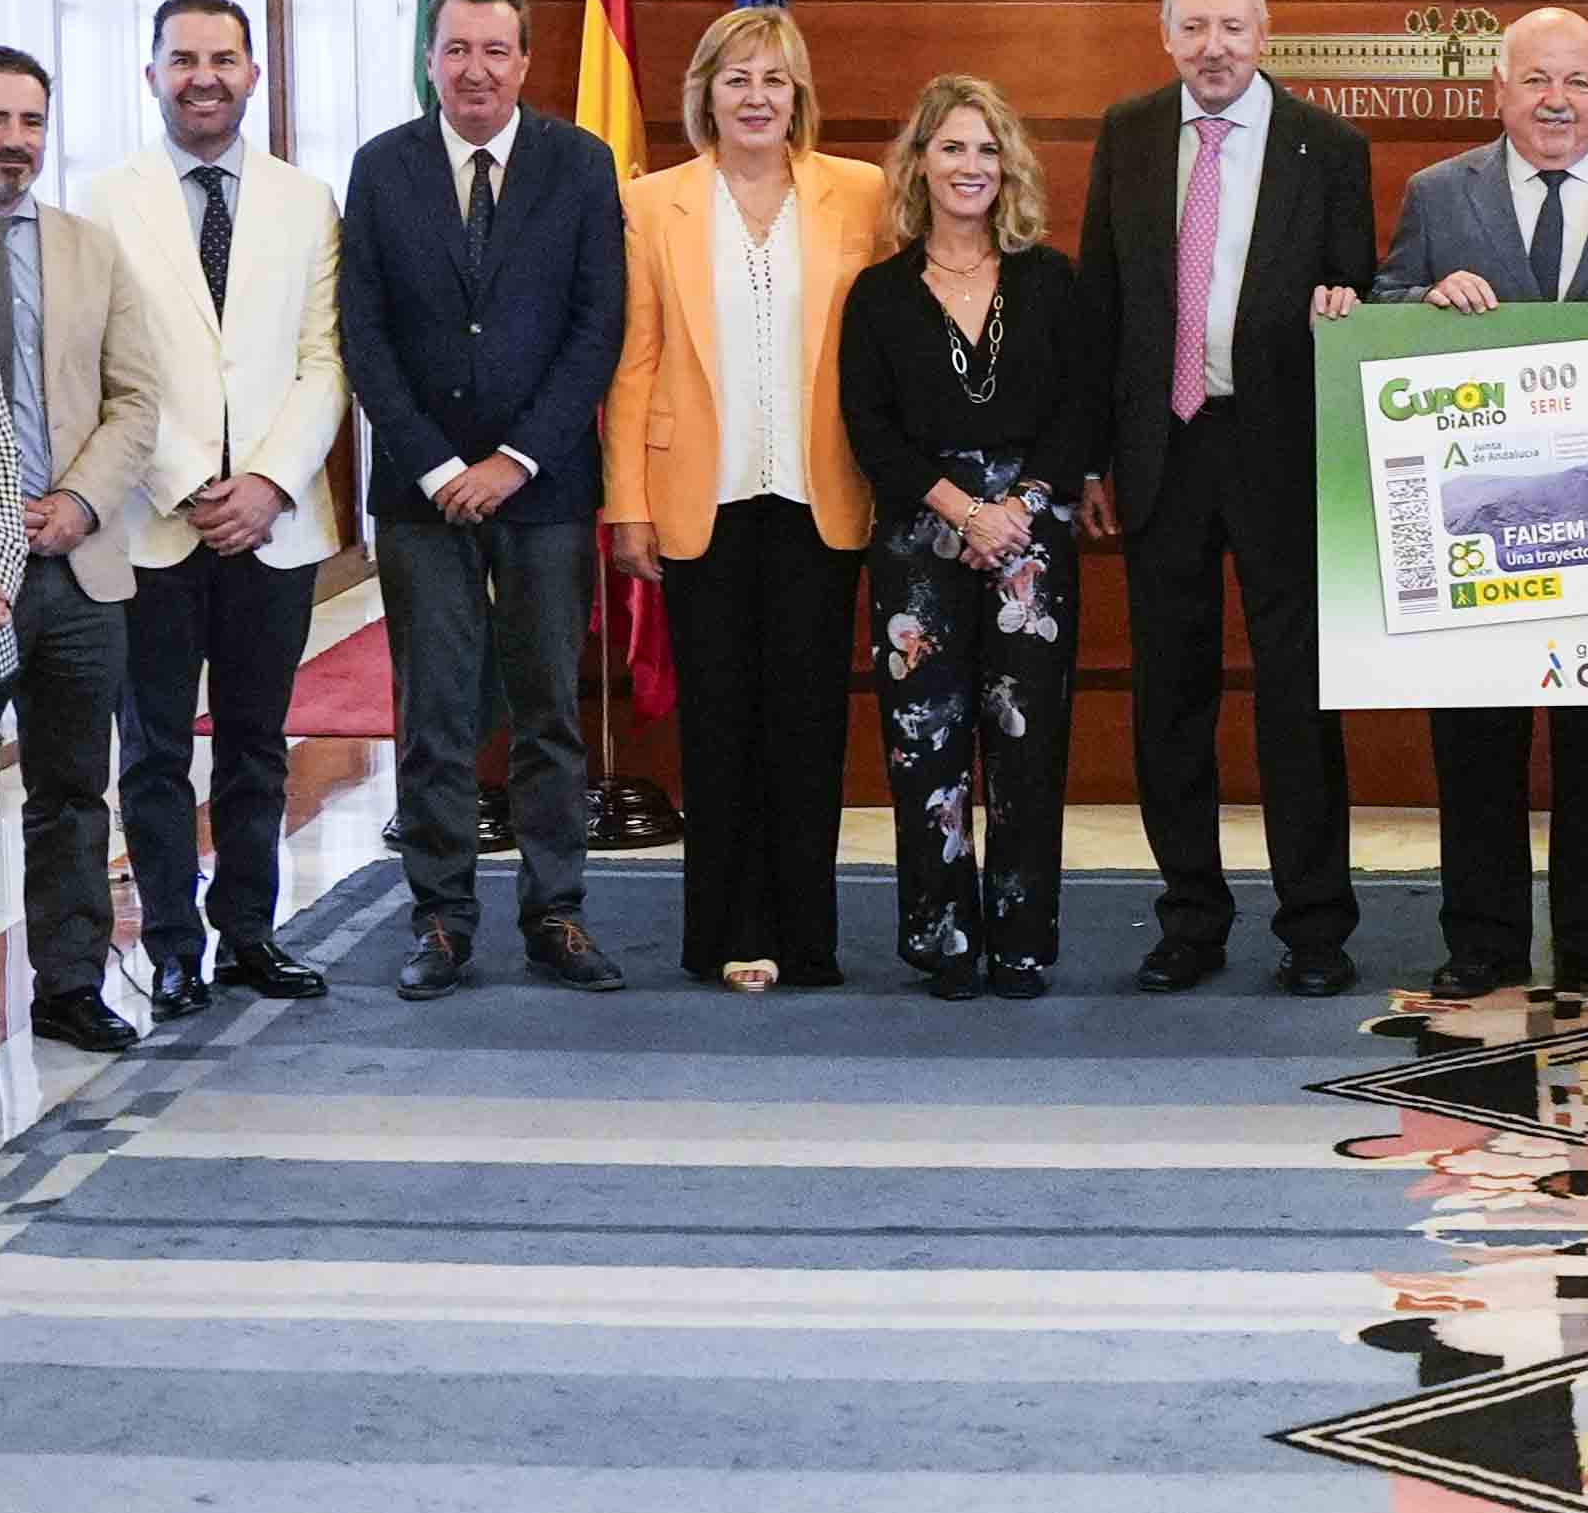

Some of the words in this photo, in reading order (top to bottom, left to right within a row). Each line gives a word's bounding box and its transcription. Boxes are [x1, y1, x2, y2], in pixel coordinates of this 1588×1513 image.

[1444, 87, 1484, 119] DE
[1519, 363, 1577, 392] 000
[1531, 397, 1572, 415] SERIE
[1502, 519, 1585, 546] FAISEM
[1448, 539, 1485, 577] 85
[1506, 551, 1534, 567] Una
[1483, 577, 1556, 601] ONCE
